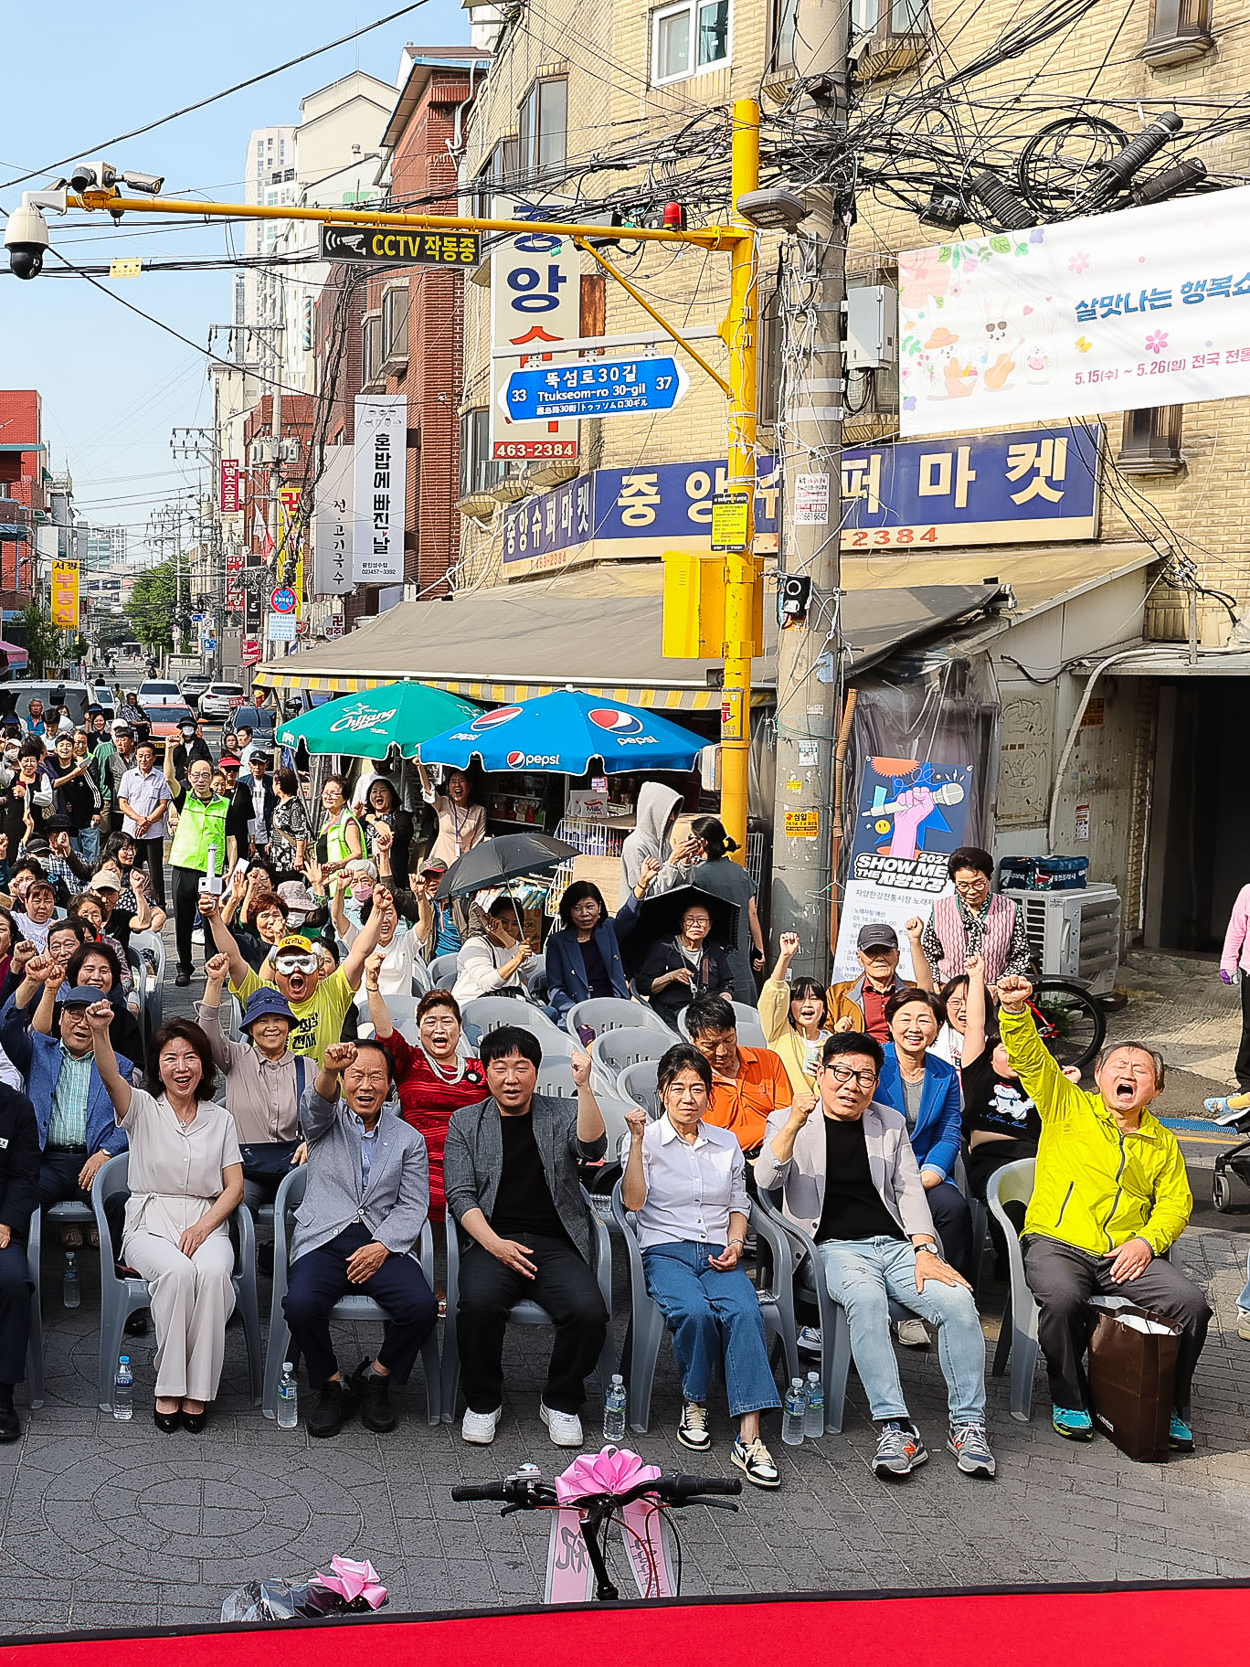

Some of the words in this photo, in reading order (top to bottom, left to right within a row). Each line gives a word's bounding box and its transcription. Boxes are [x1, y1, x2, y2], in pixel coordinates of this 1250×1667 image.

[372, 234, 421, 258] CCTV
[424, 235, 476, 262] 작동중
[1074, 287, 1173, 323] 살맛나는
[1191, 352, 1221, 369] 전국
[537, 388, 609, 402] Ttukseom-ro
[612, 382, 647, 398] 30-gil
[655, 376, 673, 391] 37
[511, 388, 528, 402] 33
[496, 443, 574, 457] 463-2384
[373, 432, 391, 490] 혼밥에
[372, 494, 391, 531] 빠진
[372, 536, 391, 555] 날
[55, 573, 76, 623] 부동산
[617, 735, 660, 747] pepsi
[525, 753, 560, 767] pepsi
[856, 855, 918, 875] SHOW
[915, 862, 949, 879] ME
[919, 853, 951, 866] 2024
[856, 868, 881, 879] THE
[877, 871, 946, 893] 자양한강
